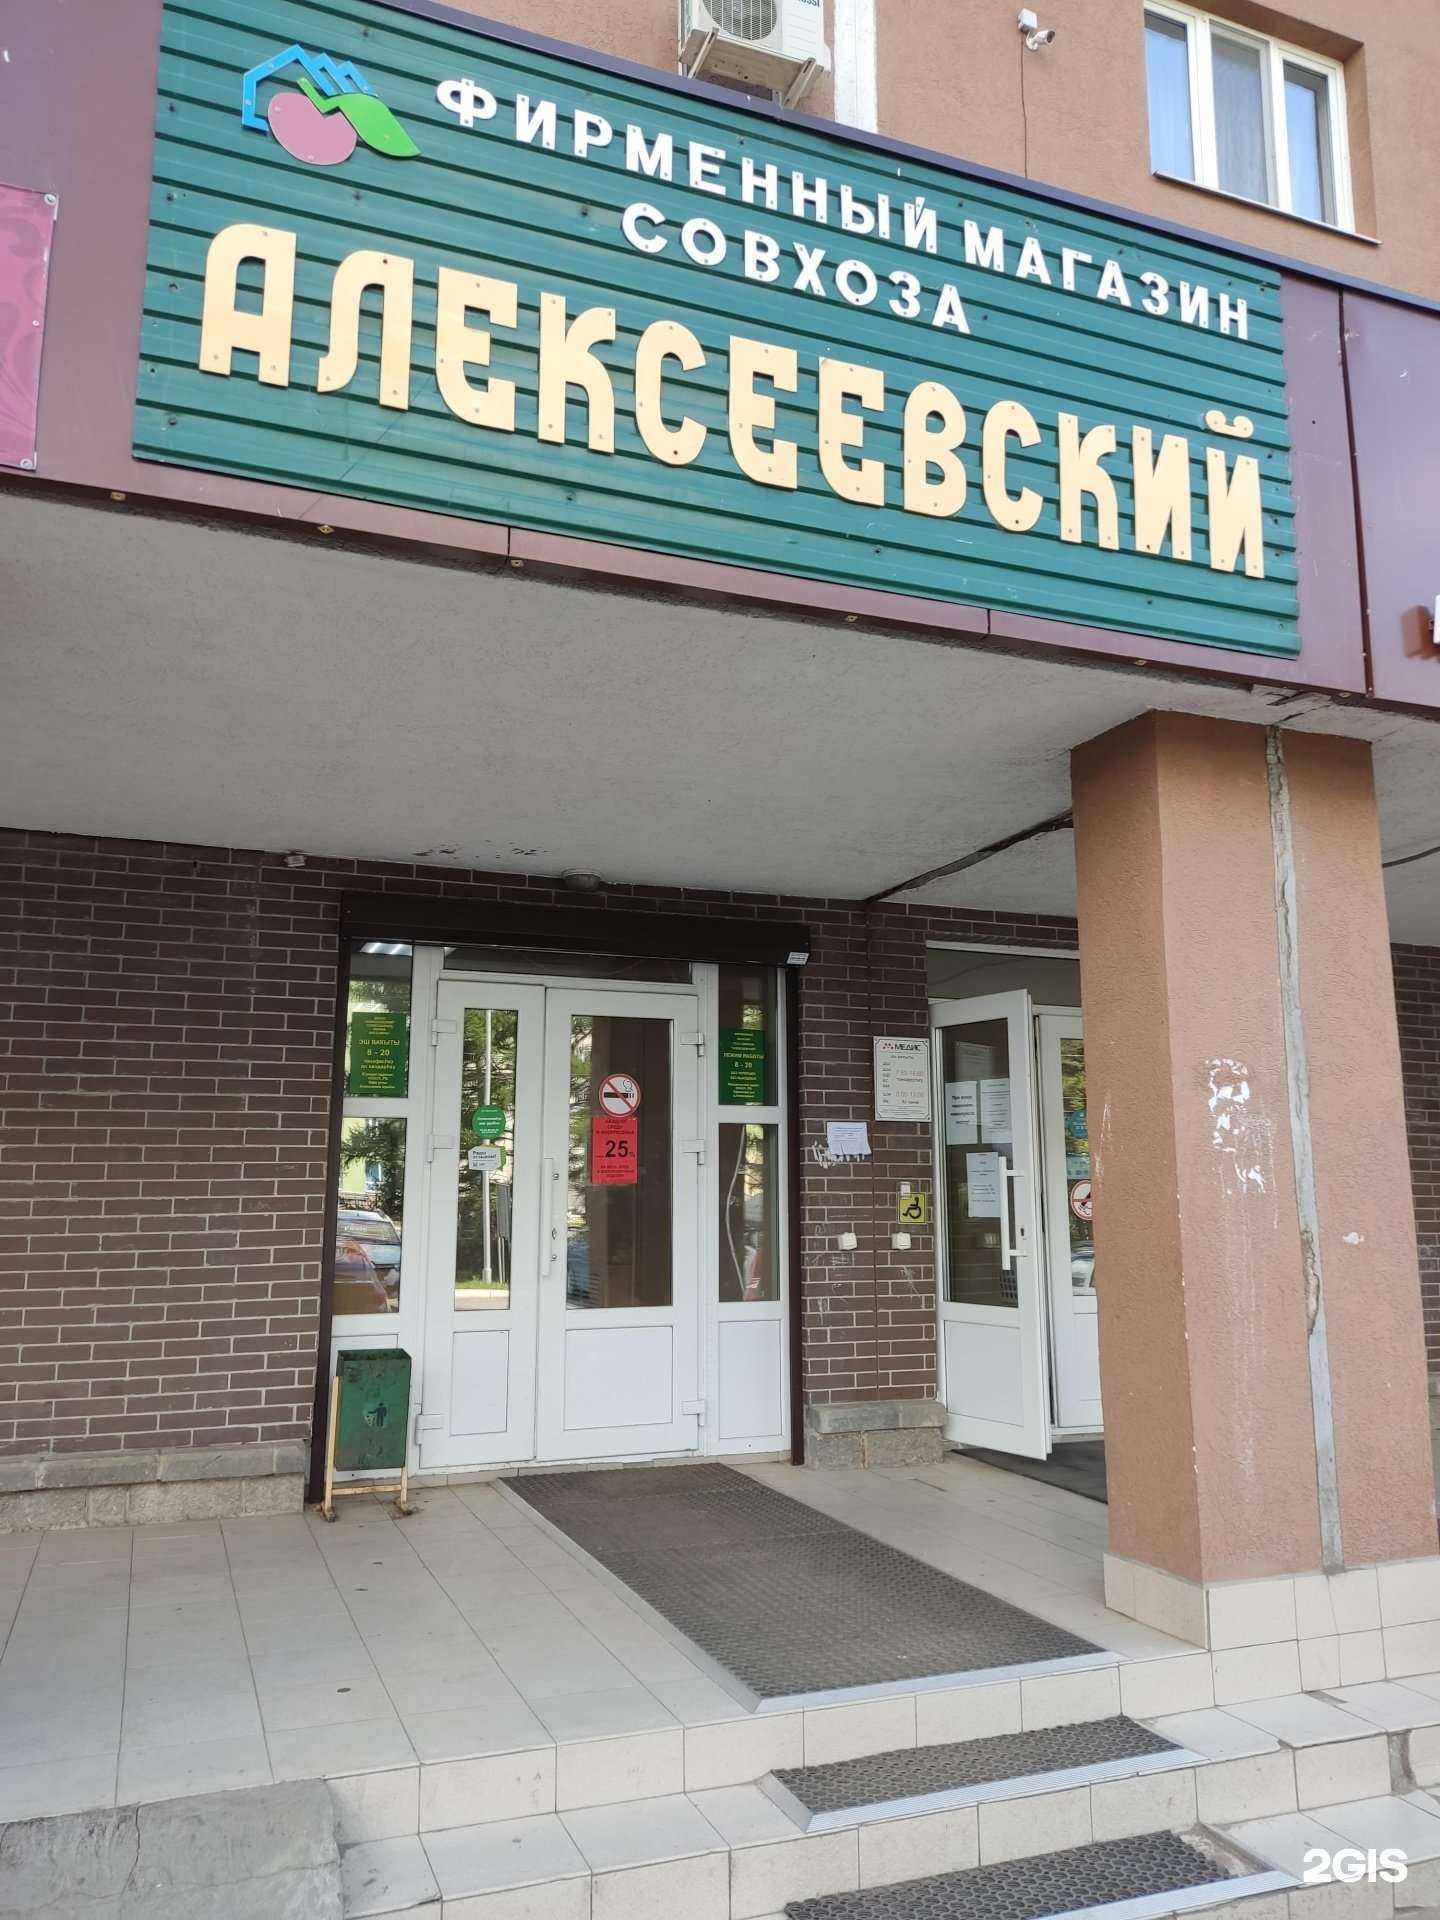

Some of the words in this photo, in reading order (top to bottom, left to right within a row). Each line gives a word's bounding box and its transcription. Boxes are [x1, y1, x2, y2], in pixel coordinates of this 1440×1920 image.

[436, 78, 938, 254] ФИРМЕННЫЙ
[963, 219, 1248, 341] МАГАЗИН
[621, 202, 971, 335] СОВХОЗА
[198, 223, 1265, 579] АЛЕКСЕЕВСКИЙ
